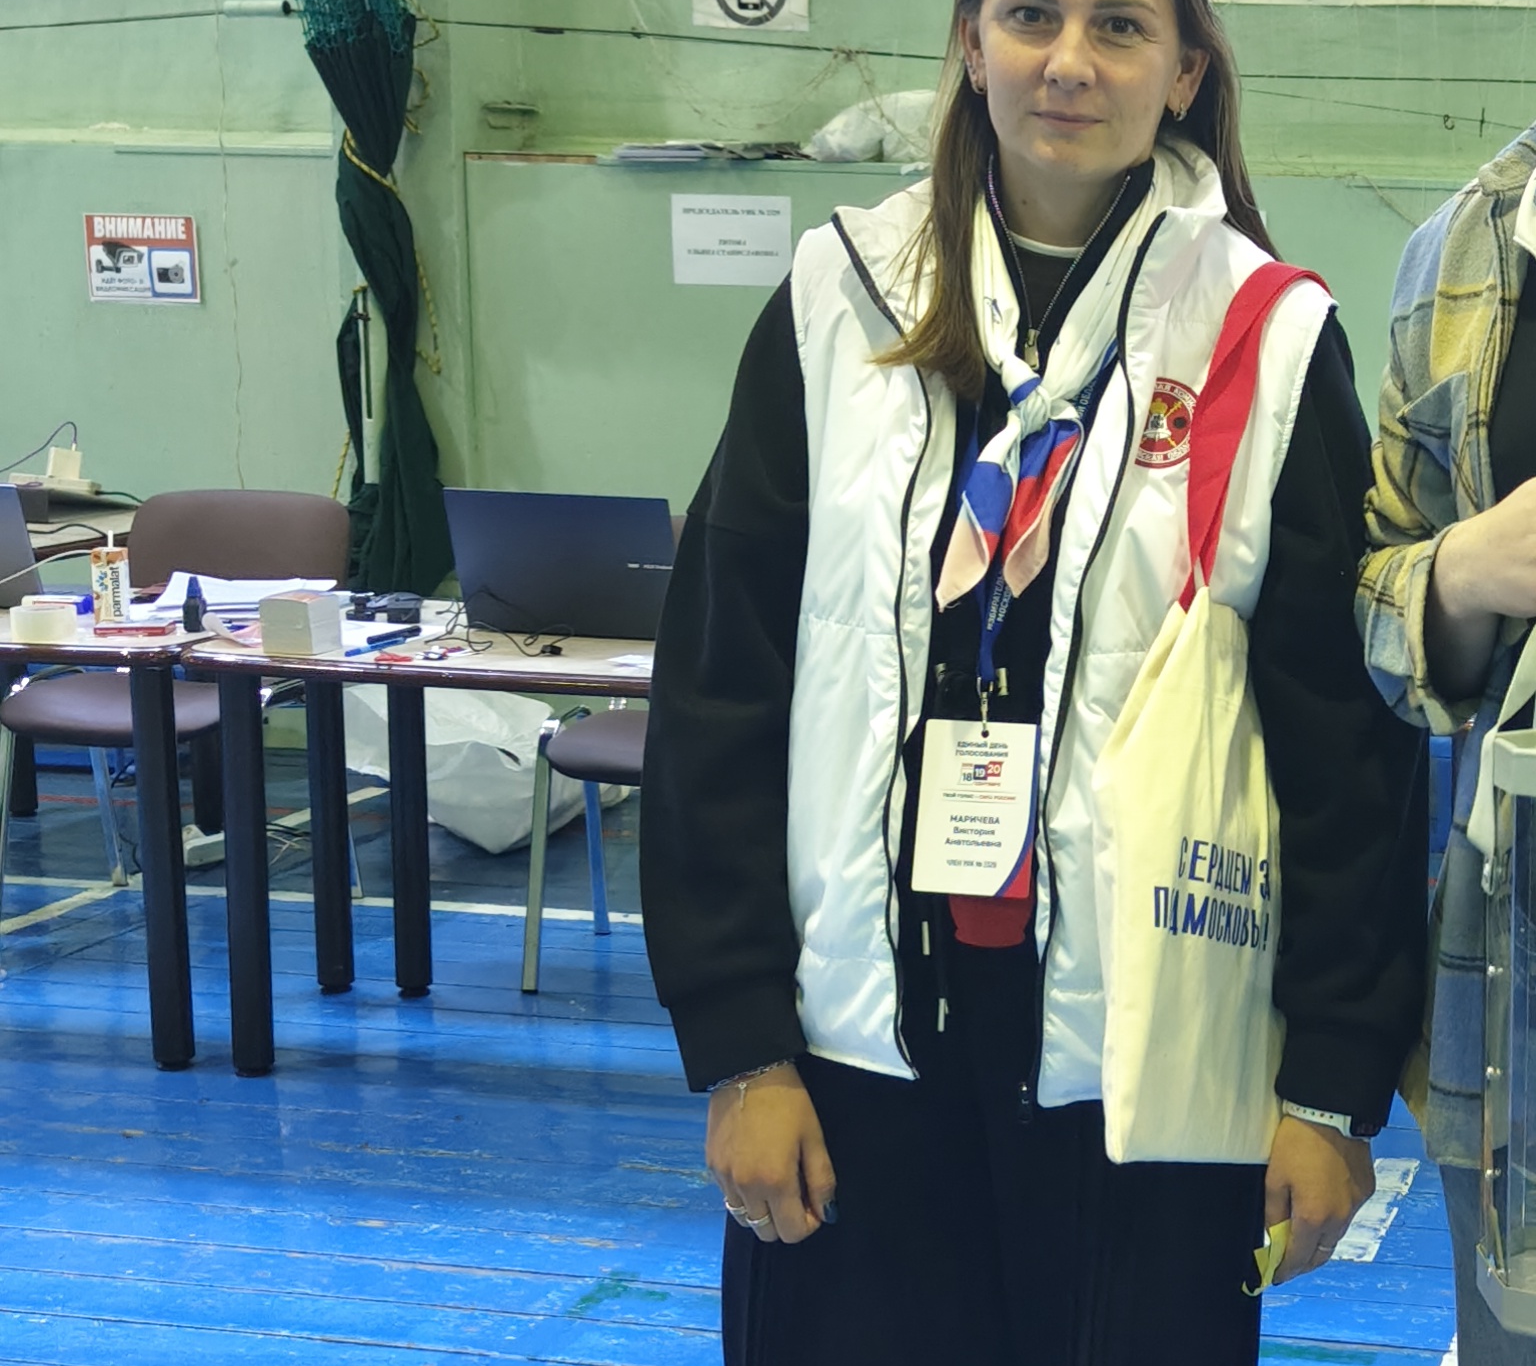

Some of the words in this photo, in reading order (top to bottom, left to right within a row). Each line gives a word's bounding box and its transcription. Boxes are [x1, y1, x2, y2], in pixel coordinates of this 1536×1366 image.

[93, 216, 187, 239] ВНИМАНИЕ
[109, 566, 124, 617] parmalat
[987, 764, 1000, 775] 20
[950, 815, 1000, 825] МАРИЧЕВА
[953, 826, 996, 837] Виктория
